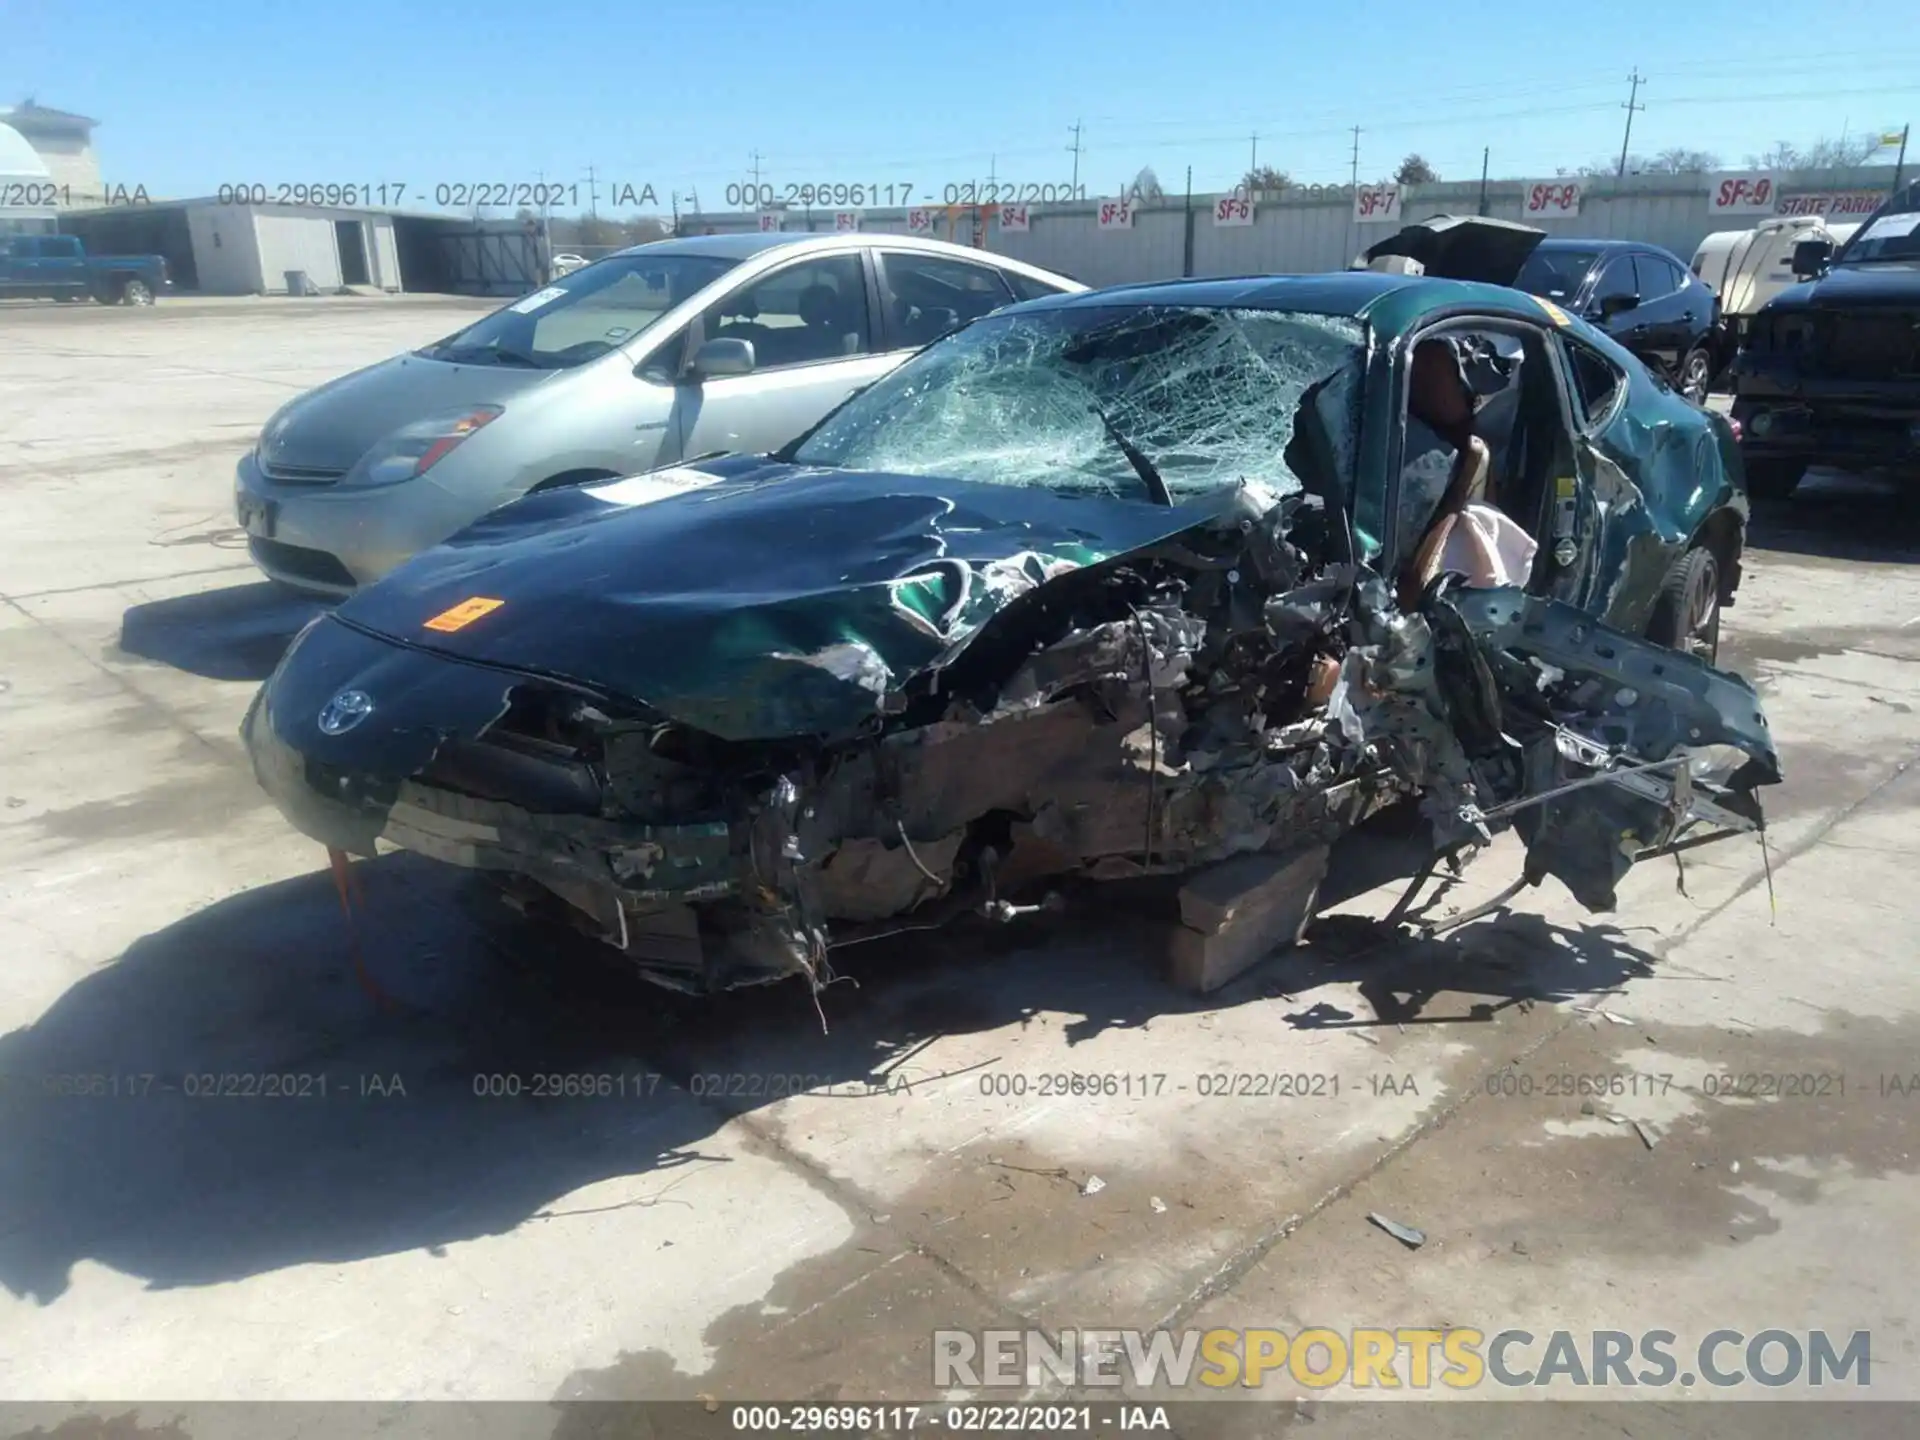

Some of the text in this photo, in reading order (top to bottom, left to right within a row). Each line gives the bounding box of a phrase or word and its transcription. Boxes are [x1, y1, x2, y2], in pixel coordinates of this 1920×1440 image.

[1359, 192, 1396, 216] SF-7
[1529, 184, 1574, 210] SF-8
[1781, 198, 1829, 214] STATE
[1101, 203, 1128, 225] SF-5
[1217, 199, 1249, 220] SF-6
